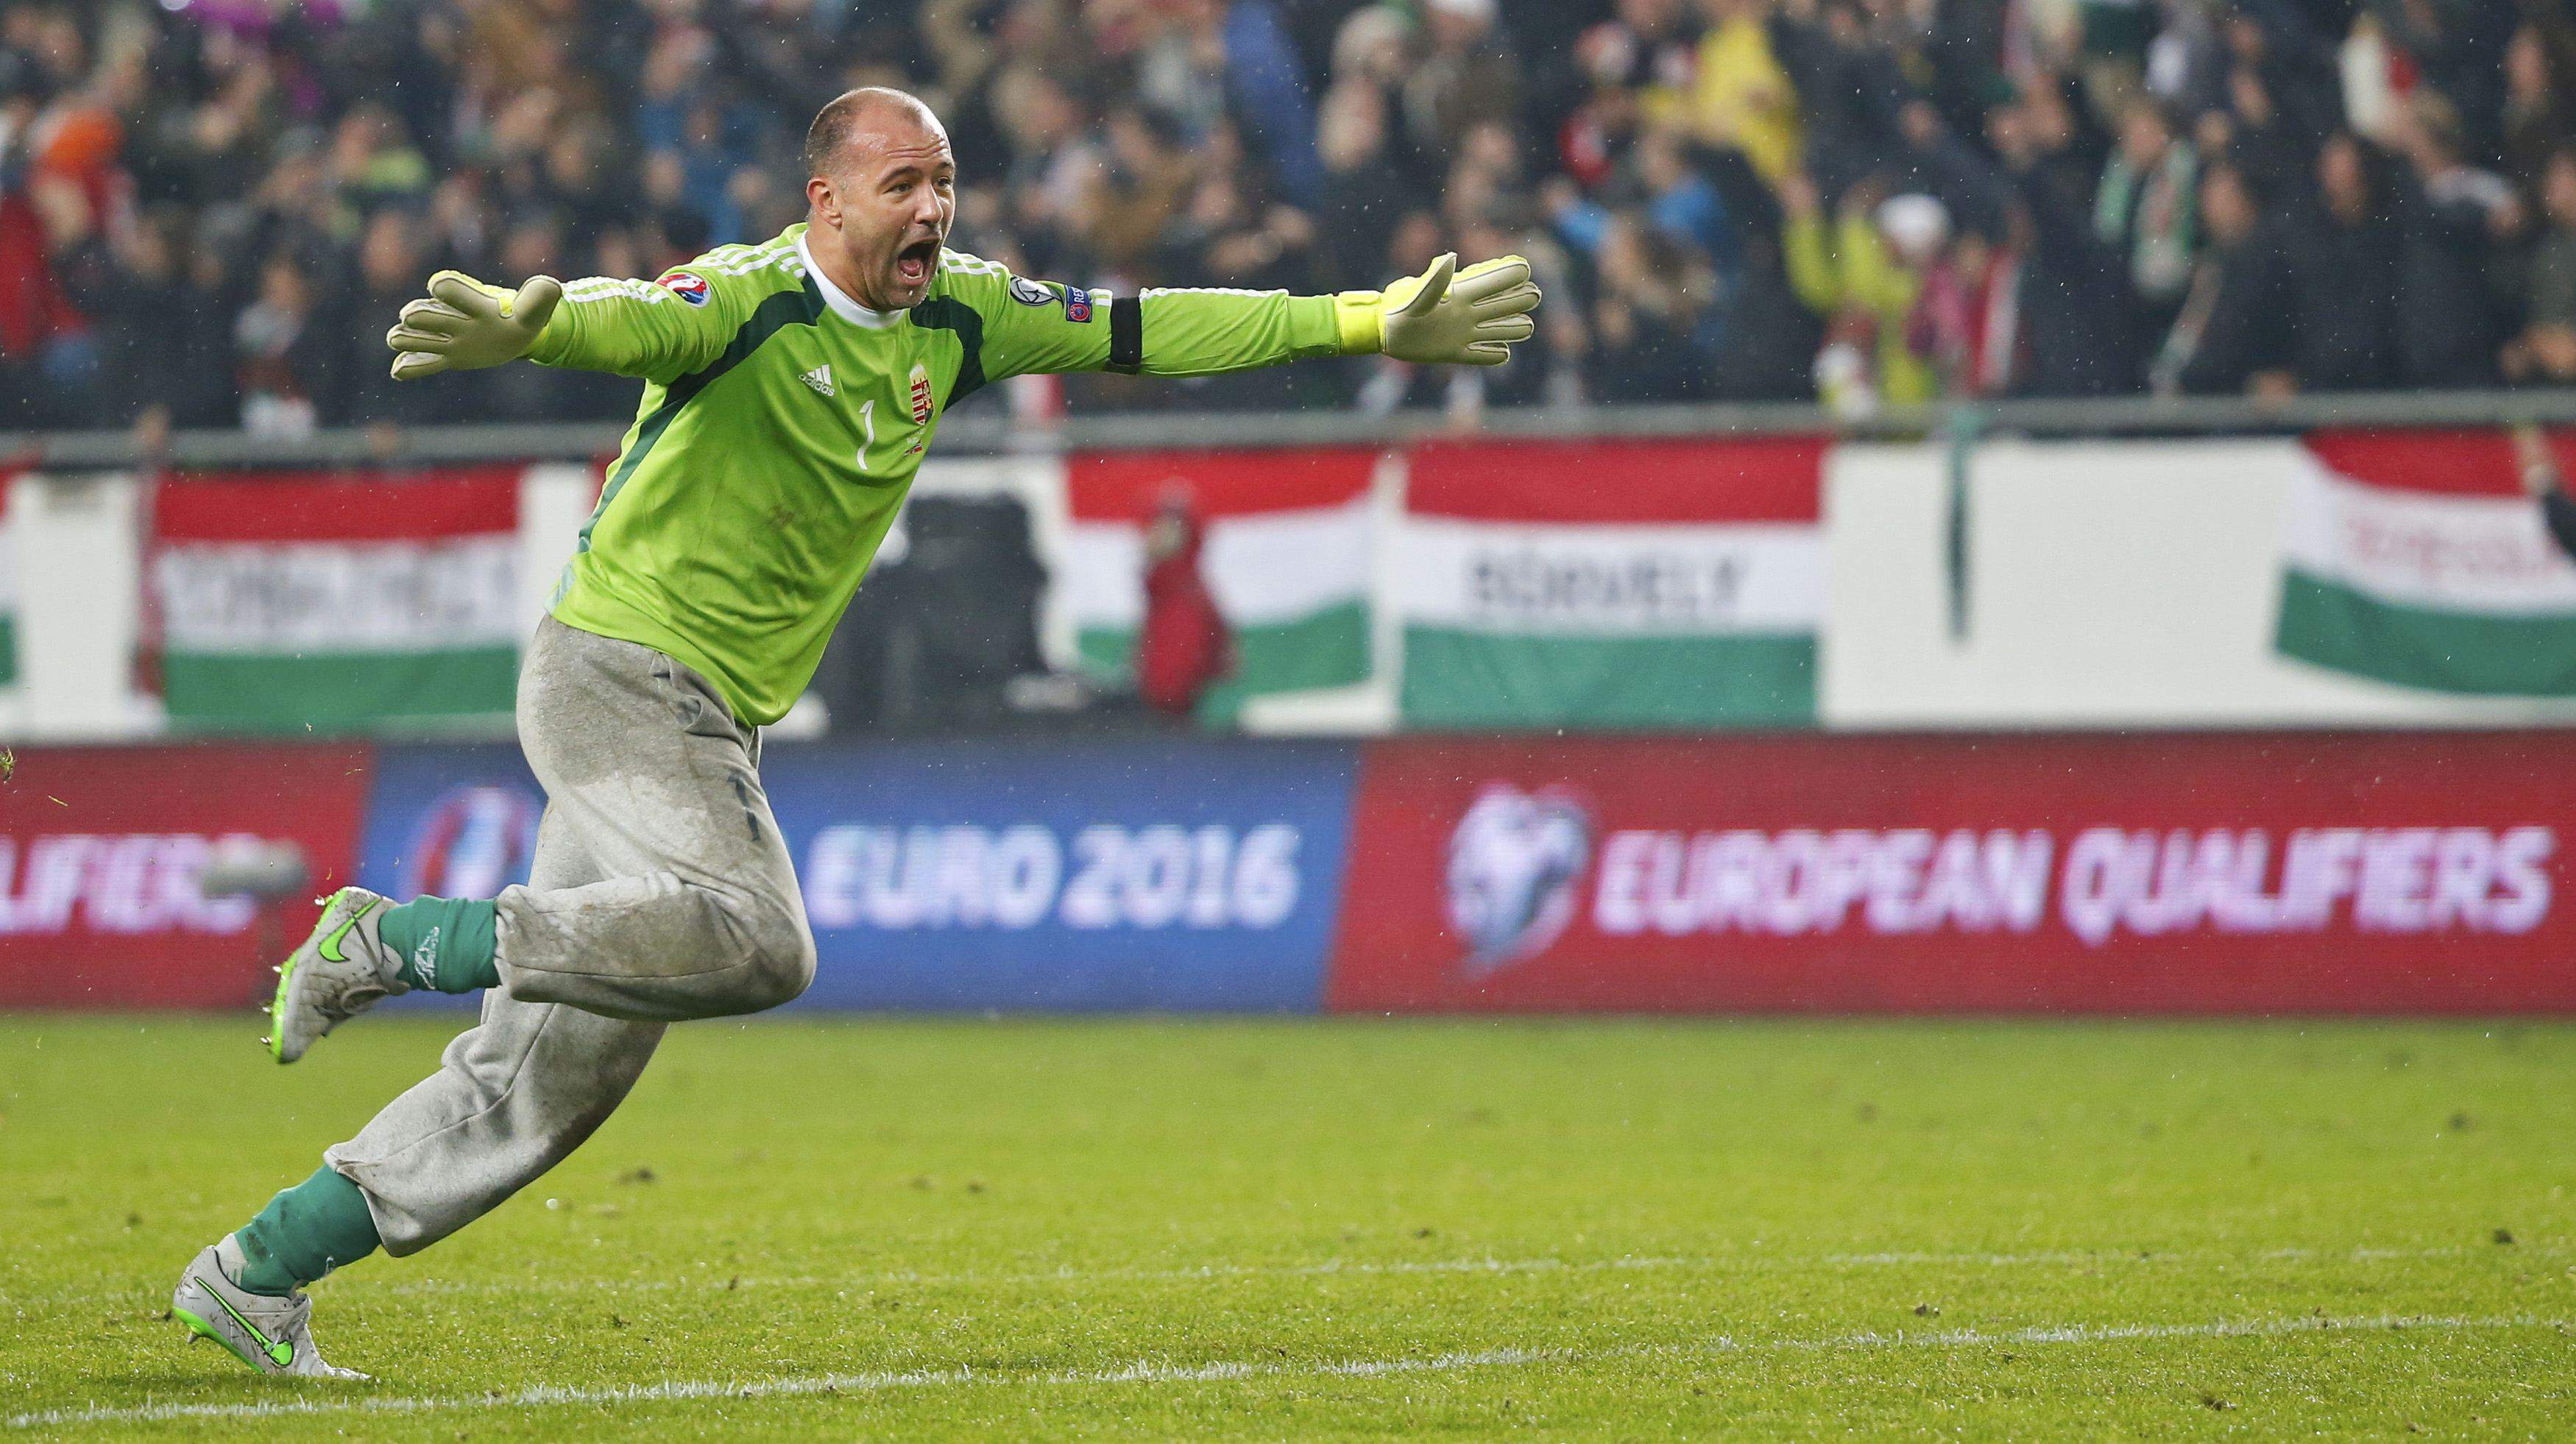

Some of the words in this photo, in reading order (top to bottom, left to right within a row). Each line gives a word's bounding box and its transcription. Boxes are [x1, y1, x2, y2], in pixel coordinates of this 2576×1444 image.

[798, 374, 835, 397] adidas
[856, 400, 875, 470] 1
[808, 823, 1062, 930] EURO
[1061, 823, 1303, 930] 2016
[1593, 827, 2055, 937] EUROPEAN
[2063, 825, 2558, 948] QUALIFIERS
